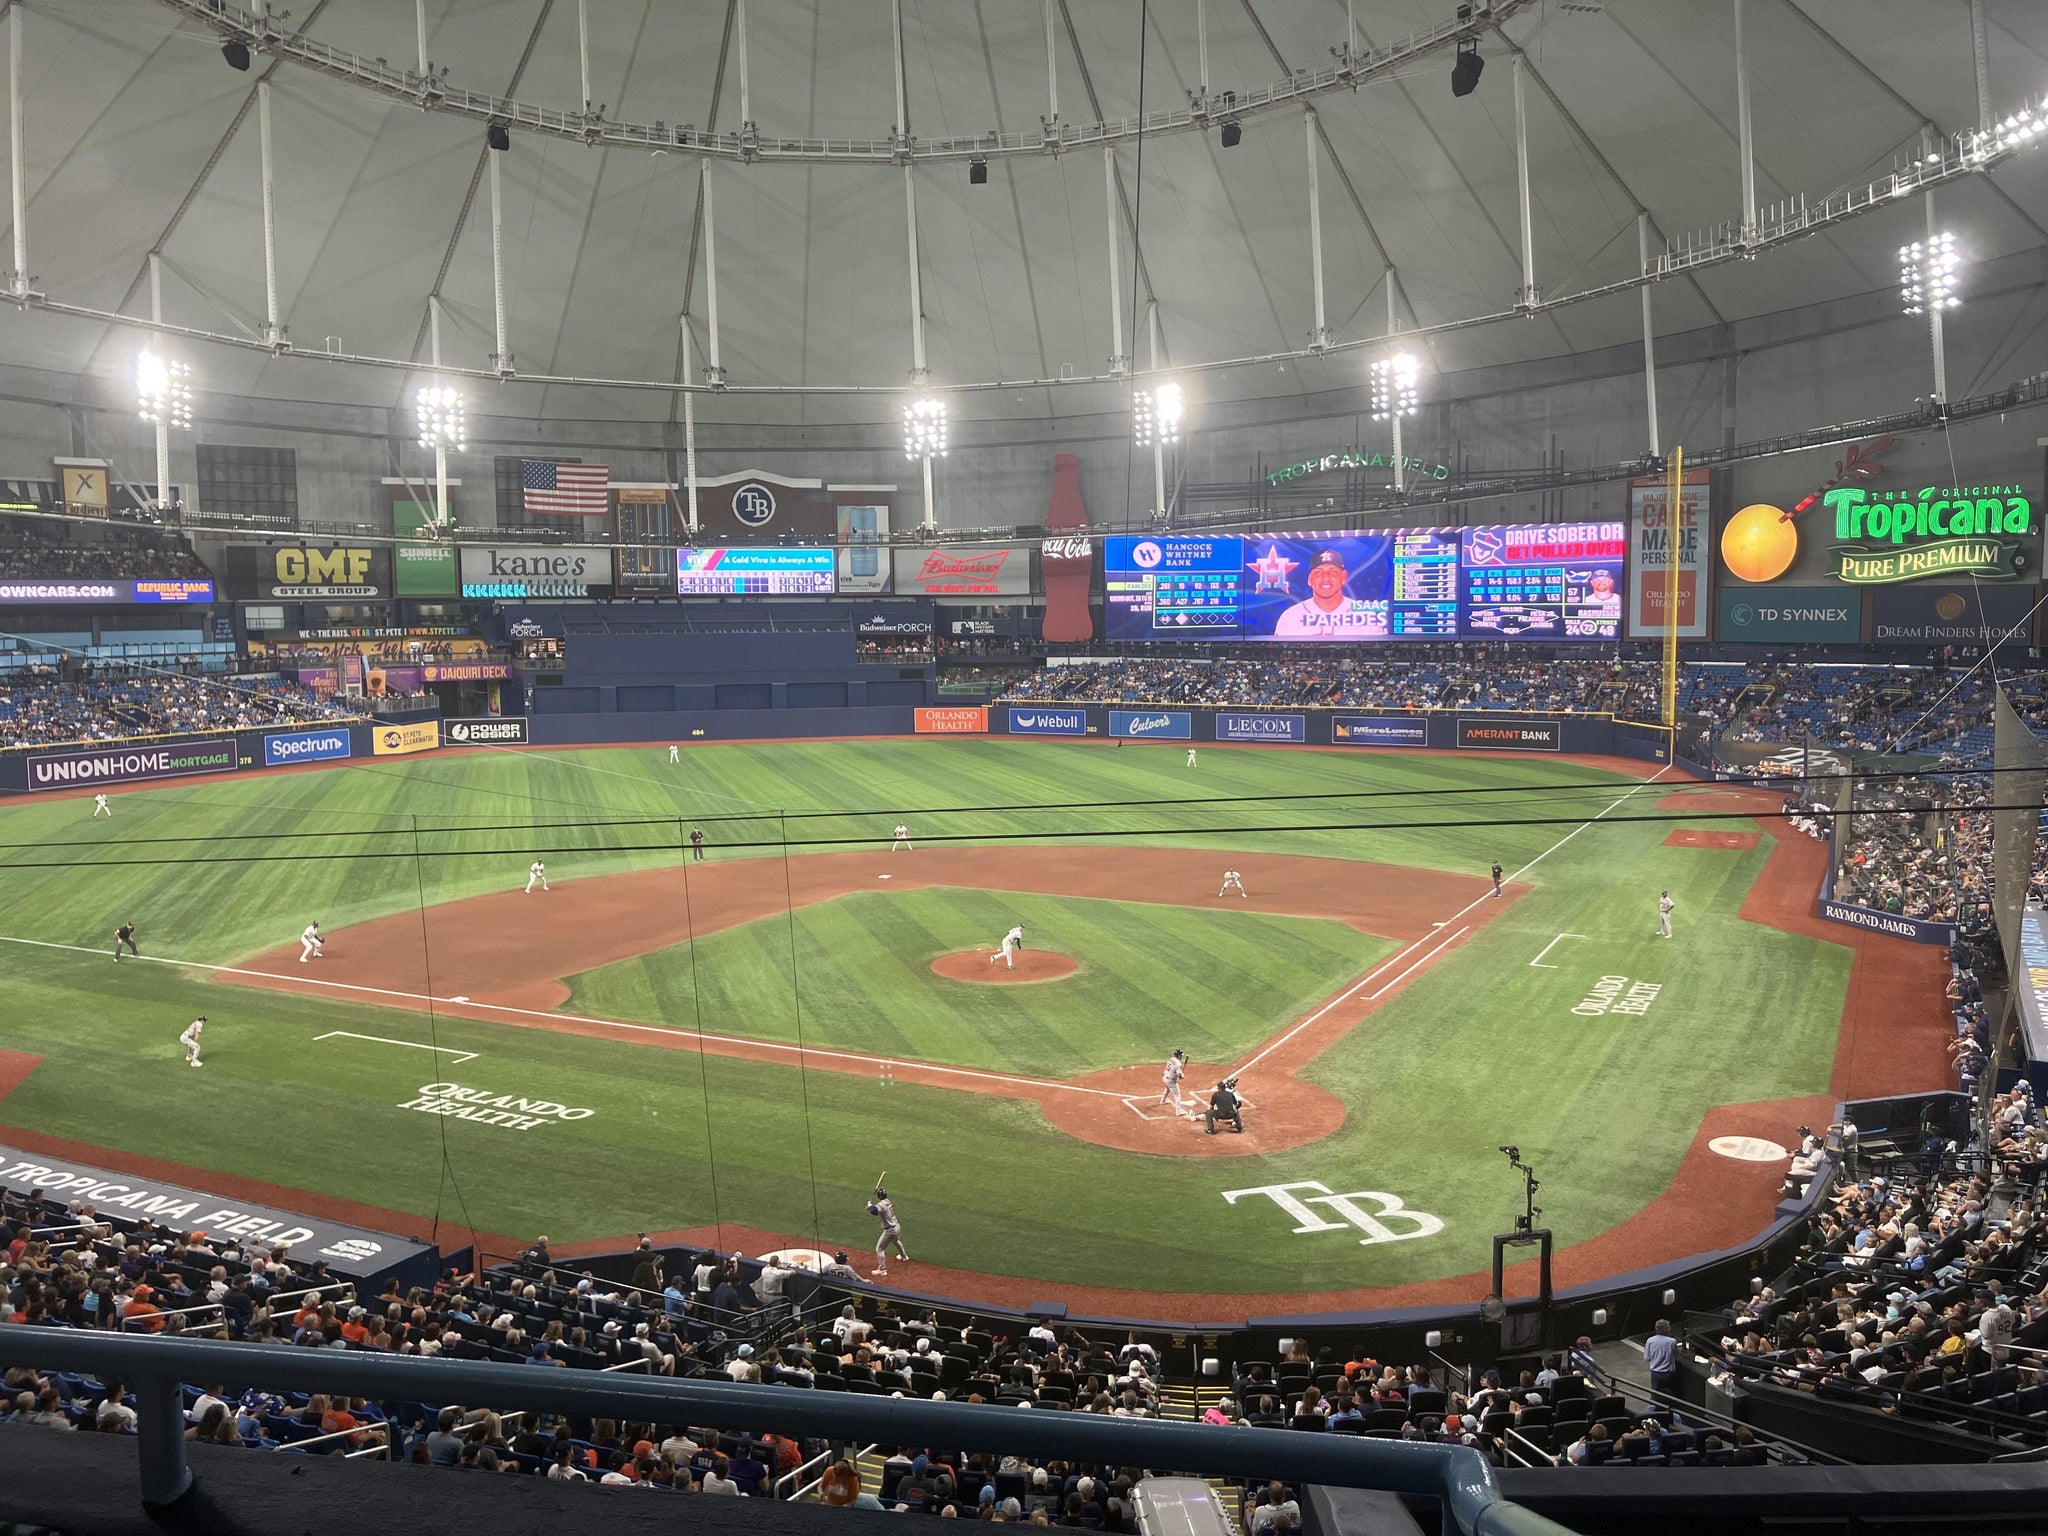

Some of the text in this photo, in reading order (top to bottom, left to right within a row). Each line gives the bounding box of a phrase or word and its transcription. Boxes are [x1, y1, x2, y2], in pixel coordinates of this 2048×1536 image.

[1266, 452, 1384, 486] TROPICANA
[1642, 493, 1667, 502] MAJOR
[1872, 484, 2022, 501] THE ORIGINAL
[741, 492, 769, 518] TB
[1823, 488, 2030, 544] Tropicana
[1506, 524, 1623, 546] DRIVE SOBER OR
[1506, 545, 1528, 560] GET
[275, 548, 372, 584] GMF
[487, 550, 586, 577] kane's
[751, 556, 768, 564] Viva
[777, 557, 805, 566] Always
[922, 557, 1000, 575] Budweiser
[1841, 545, 1999, 578] PURE PREMIUM
[814, 573, 832, 585] 0-2
[137, 583, 210, 593] REPUBLIC BANK
[280, 587, 371, 595] STEEL GROUP
[1567, 588, 1578, 596] 57
[1353, 600, 1388, 610] ISAAC
[1306, 612, 1387, 626] PAREDES
[1758, 609, 1847, 621] TD SYNNEX
[299, 630, 309, 638] WE
[317, 629, 331, 638] THE
[510, 629, 543, 637] PORCH
[860, 623, 932, 632] Budweiser PORCH
[1565, 625, 1580, 635] 24
[1599, 625, 1615, 636] 48
[1877, 625, 2026, 638] DREAM FINDERS HOMES
[440, 665, 507, 680] DAIQUIRI DECK
[926, 711, 978, 720] ORLANDO
[1038, 716, 1078, 728] Webull
[470, 724, 520, 733] POWER
[932, 721, 974, 730] HEALTH
[1129, 714, 1171, 735] Culver's
[1228, 719, 1291, 733] LECOM
[1353, 726, 1423, 735] MicroLumen
[1466, 730, 1550, 741] AMERANT BANK
[272, 737, 339, 758] Spectrum
[170, 753, 229, 768] MORTGAGE
[1826, 906, 1916, 937] RAYMOND JAMES
[1570, 975, 1629, 1016] ORLANDO
[1610, 981, 1662, 1016] HEALTH
[418, 1082, 595, 1120] ORLANDO
[397, 1095, 548, 1131] HEALTH
[8, 1161, 200, 1220] TROPICANA
[193, 1209, 314, 1246] FIELD
[1220, 1180, 1445, 1245] TB
